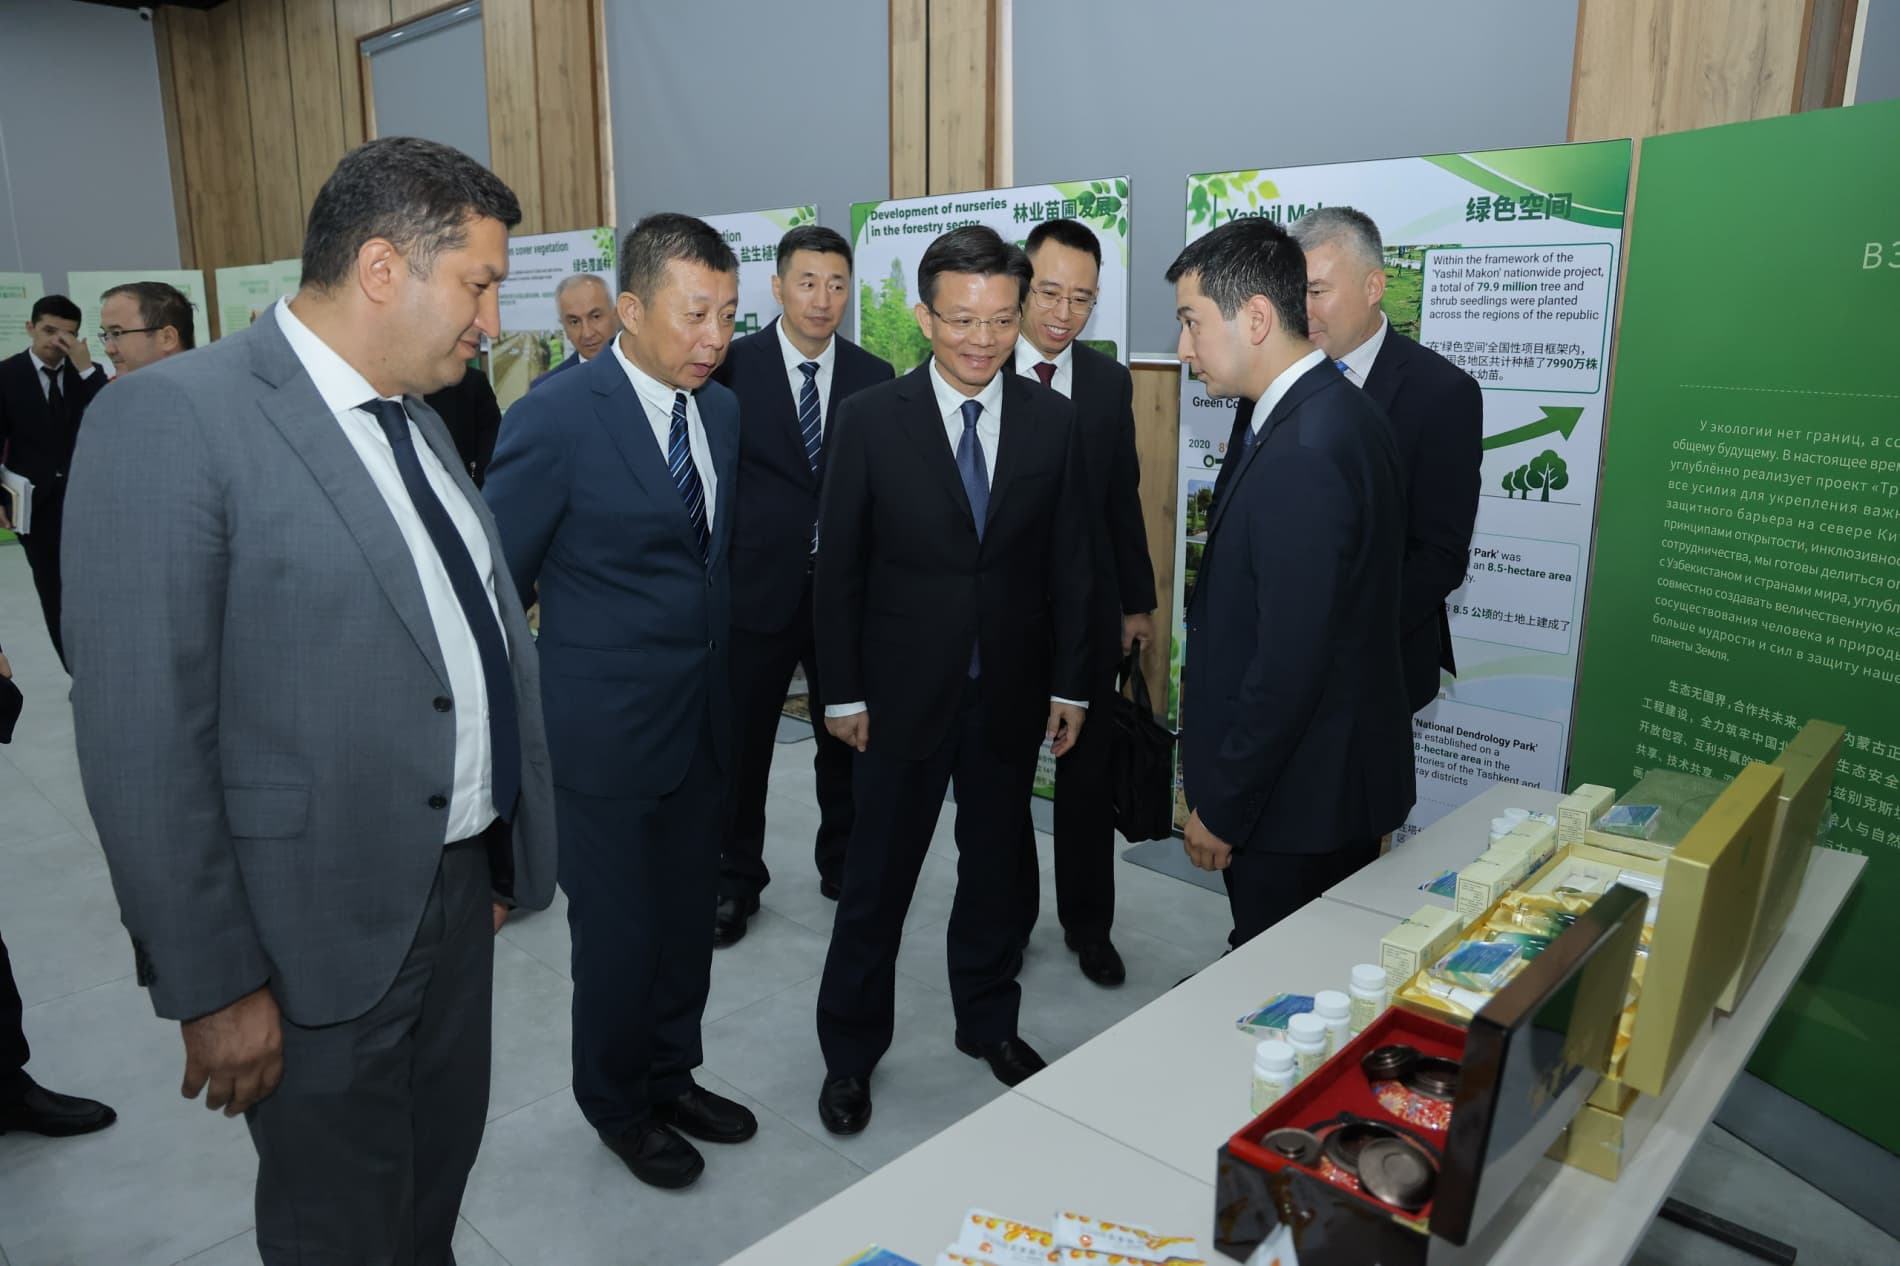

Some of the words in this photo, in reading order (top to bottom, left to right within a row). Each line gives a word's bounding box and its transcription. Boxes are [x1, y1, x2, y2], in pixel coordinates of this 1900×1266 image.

[871, 206, 938, 221] Development
[942, 202, 953, 214] of
[955, 197, 1007, 213] nurseries
[1465, 192, 1572, 223] 绿色空间
[871, 226, 880, 237] in
[884, 224, 900, 235] the
[903, 222, 943, 235] forestry
[534, 243, 568, 256] vegetation
[1433, 255, 1463, 265] Within
[1466, 254, 1482, 264] the
[1485, 253, 1540, 264] framework
[1542, 252, 1555, 263] of
[1556, 252, 1574, 263] the
[1504, 266, 1561, 278] nationwide
[1564, 267, 1604, 280] project,
[1431, 284, 1437, 292] a
[1440, 282, 1462, 292] total
[1464, 282, 1475, 292] of
[1477, 282, 1500, 292] 79.9
[1502, 282, 1538, 292] million
[1540, 282, 1560, 292] tree
[1564, 281, 1584, 292] and
[1430, 296, 1458, 306] shrub
[1460, 295, 1508, 308] seedlings
[1510, 298, 1536, 306] were
[1538, 295, 1578, 308] planted
[1430, 311, 1462, 320] across
[1464, 310, 1480, 320] the
[1482, 310, 1520, 322] regions
[1523, 310, 1534, 320] of
[1536, 310, 1553, 320] the
[1556, 310, 1599, 322] republic
[1192, 396, 1223, 408] Green
[1188, 439, 1210, 449] 2020
[1700, 420, 1707, 431] У
[1710, 423, 1772, 437] экологии
[1777, 428, 1802, 440] нет
[1806, 431, 1865, 448] границ,
[1871, 436, 1879, 446] а
[1672, 439, 1716, 456] общему
[1718, 442, 1779, 462] будущему.
[1782, 449, 1791, 461] В
[1794, 452, 1868, 470] настоящее
[1670, 459, 1740, 477] углублённо
[1743, 468, 1812, 486] реализует
[1816, 477, 1868, 491] проект
[1668, 480, 1688, 491] все
[1692, 483, 1736, 497] усилия
[1740, 490, 1764, 502] для
[1768, 494, 1858, 514] укрепления
[1666, 500, 1733, 518] защитного
[1737, 508, 1793, 528] барьера
[1798, 520, 1814, 530] на
[1820, 522, 1872, 540] севере
[1664, 519, 1732, 538] принципами
[1734, 531, 1808, 554] открытости,
[1502, 552, 1521, 562] was
[1661, 539, 1752, 564] сотрудничества,
[1754, 556, 1772, 566] мы
[1774, 560, 1818, 574] готовы
[1820, 568, 1884, 587] делиться
[1474, 563, 1485, 571] an
[1488, 562, 1546, 579] 8.5-hectare
[1548, 572, 1572, 582] area
[1660, 558, 1665, 566] с
[1667, 558, 1742, 582] Узбекистаном
[1745, 576, 1752, 584] и
[1754, 576, 1812, 596] странами
[1814, 588, 1850, 606] мира,
[1453, 605, 1468, 615] 8.5
[1658, 578, 1713, 597] совместно
[1715, 590, 1772, 610] создавать
[1776, 602, 1884, 634] величественную
[1656, 596, 1758, 628] сосуществования
[1762, 620, 1822, 642] человека
[1826, 636, 1834, 646] и
[1651, 634, 1693, 652] планеты
[1694, 644, 1730, 662] Земля.
[1653, 612, 1696, 632] больше
[1698, 626, 1755, 648] мудрости
[1759, 642, 1766, 650] и
[1770, 644, 1792, 657] сил
[1796, 650, 1804, 660] в
[1808, 653, 1859, 676] защиту
[1424, 734, 1477, 752] established
[1480, 746, 1492, 755] on
[1494, 749, 1500, 757] a
[1456, 728, 1511, 748] Dendrology
[1448, 762, 1457, 772] of
[1459, 764, 1474, 776] the
[1460, 754, 1482, 765] area
[1484, 760, 1493, 768] in
[1495, 761, 1511, 772] the
[1432, 770, 1468, 786] districts
